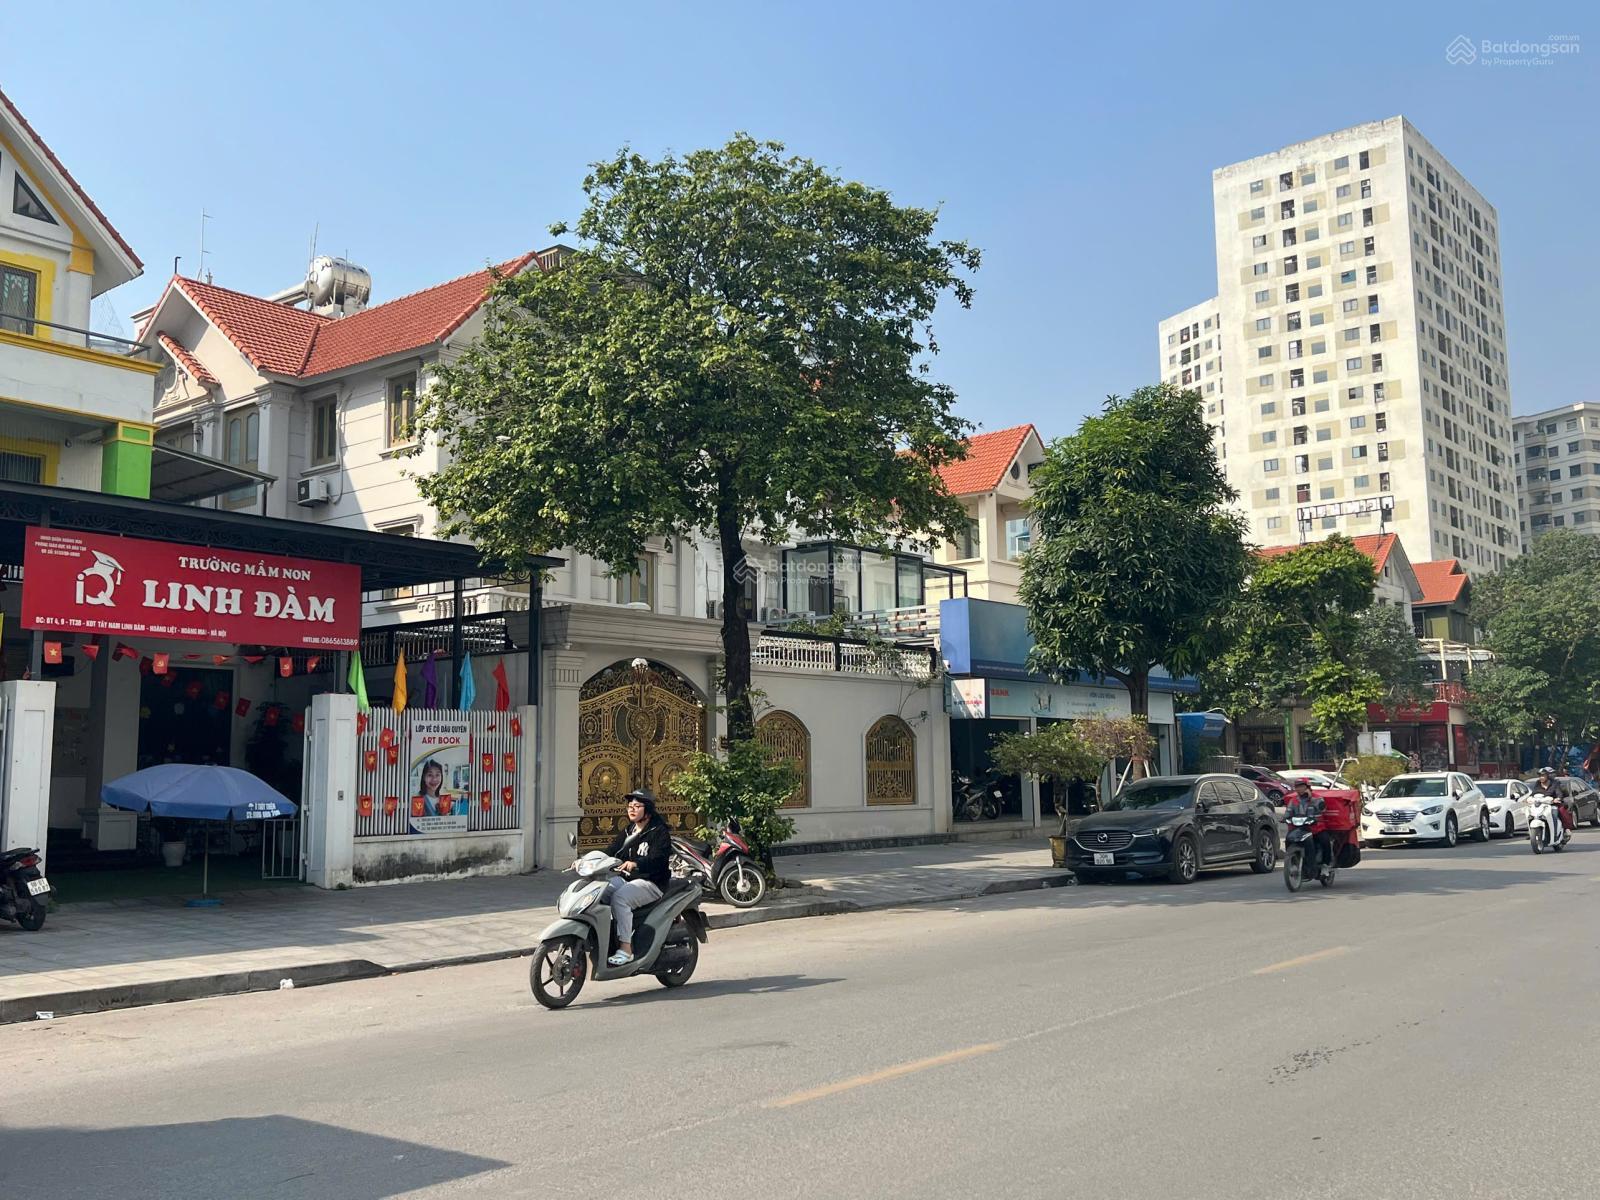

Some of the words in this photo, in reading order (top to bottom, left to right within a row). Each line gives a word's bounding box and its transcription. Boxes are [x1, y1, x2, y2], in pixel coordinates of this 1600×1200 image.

[178, 556, 241, 574] TRƯỜNG
[244, 559, 280, 579] MẦM
[282, 568, 312, 581] NON
[142, 579, 244, 615] LINH
[253, 585, 336, 623] ĐÀM
[422, 736, 436, 744] ART
[438, 736, 460, 744] BOOK
